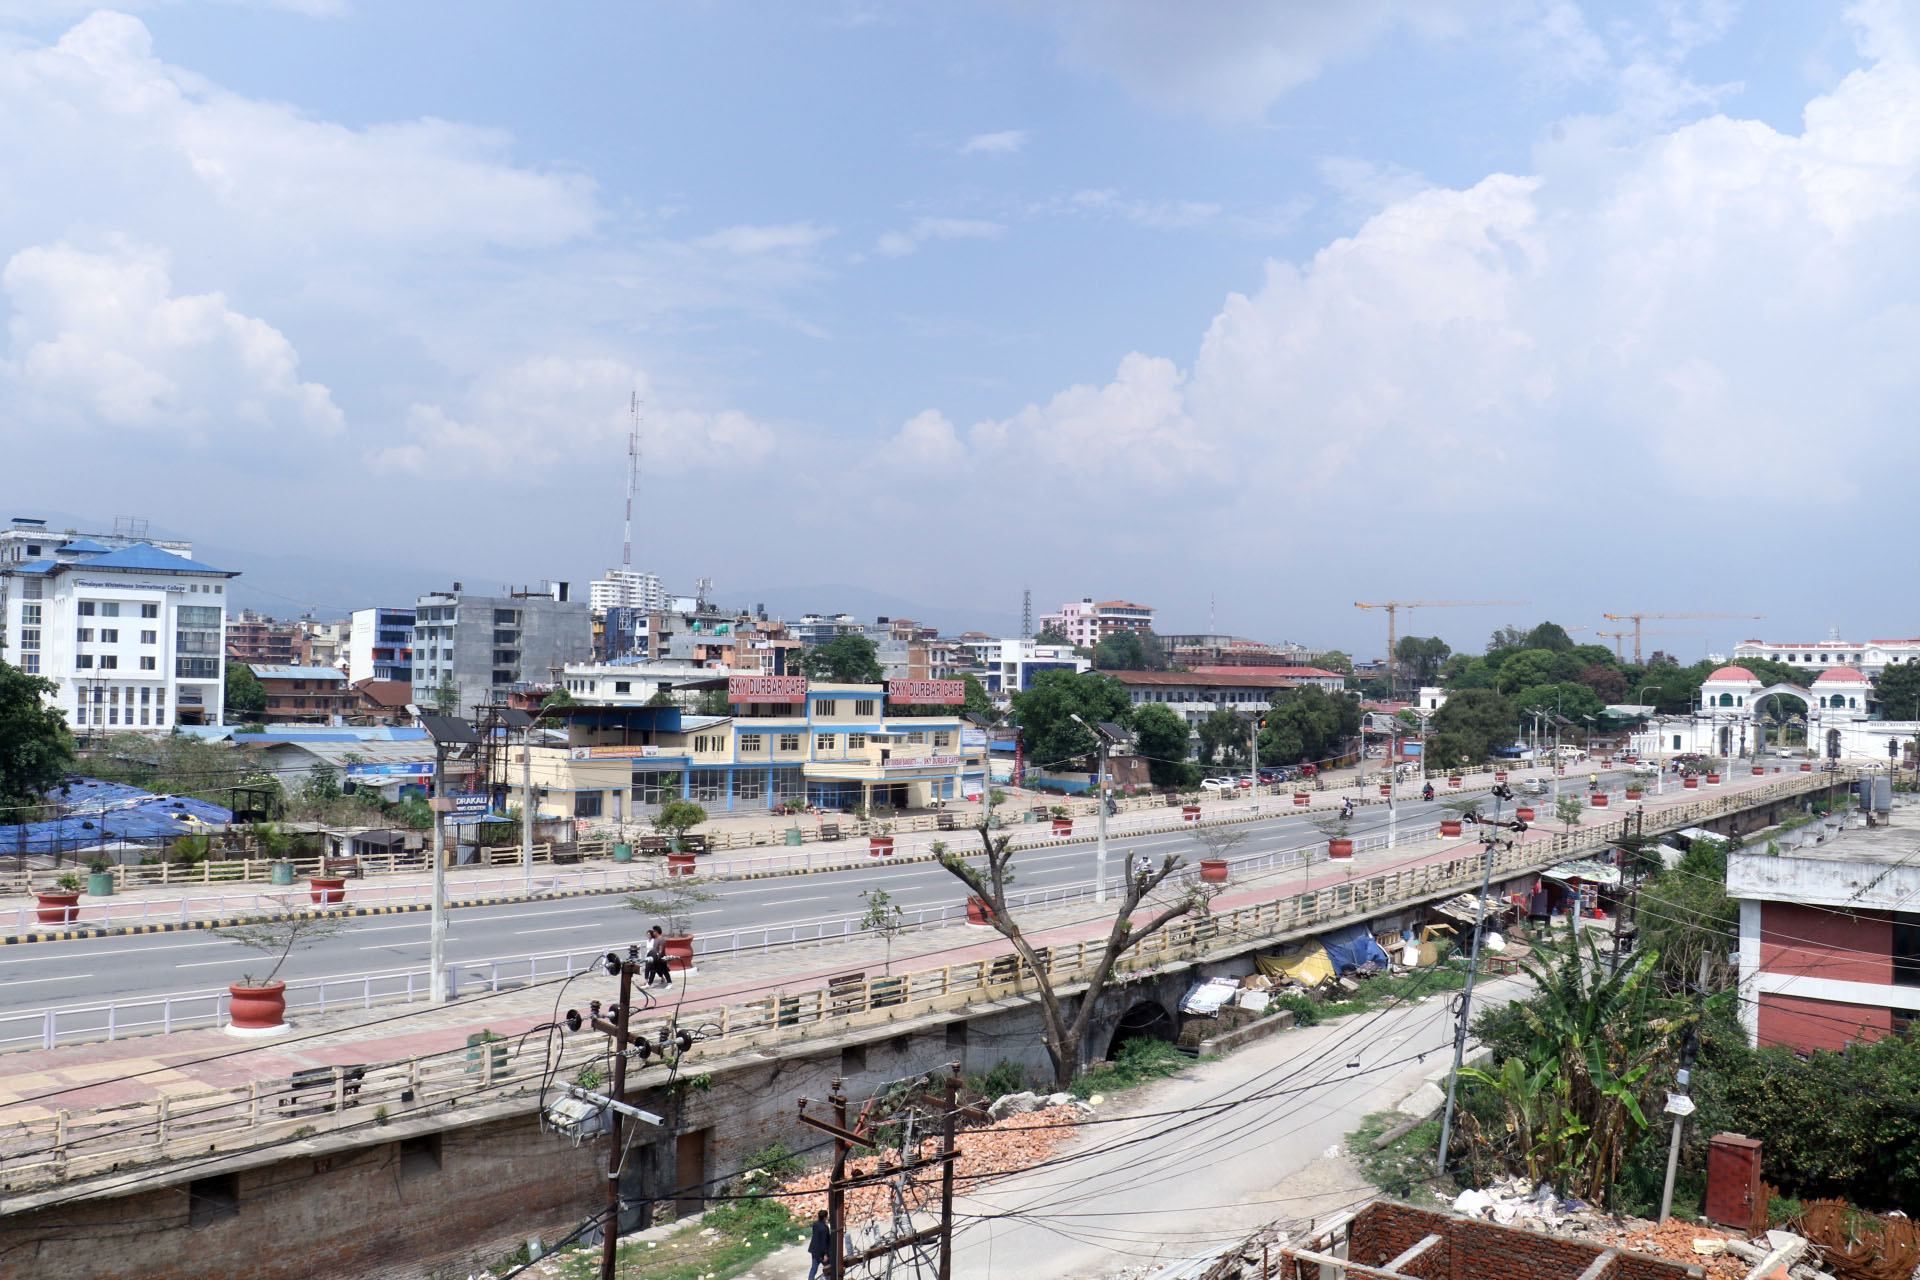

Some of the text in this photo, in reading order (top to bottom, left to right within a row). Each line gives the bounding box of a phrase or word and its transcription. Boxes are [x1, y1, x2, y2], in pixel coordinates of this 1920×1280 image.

[729, 678, 806, 696] SKY DURBAR CAFE
[890, 681, 963, 698] SKY DURBAR CAFE
[932, 757, 948, 765] DURBAR
[948, 756, 959, 764] CAFE
